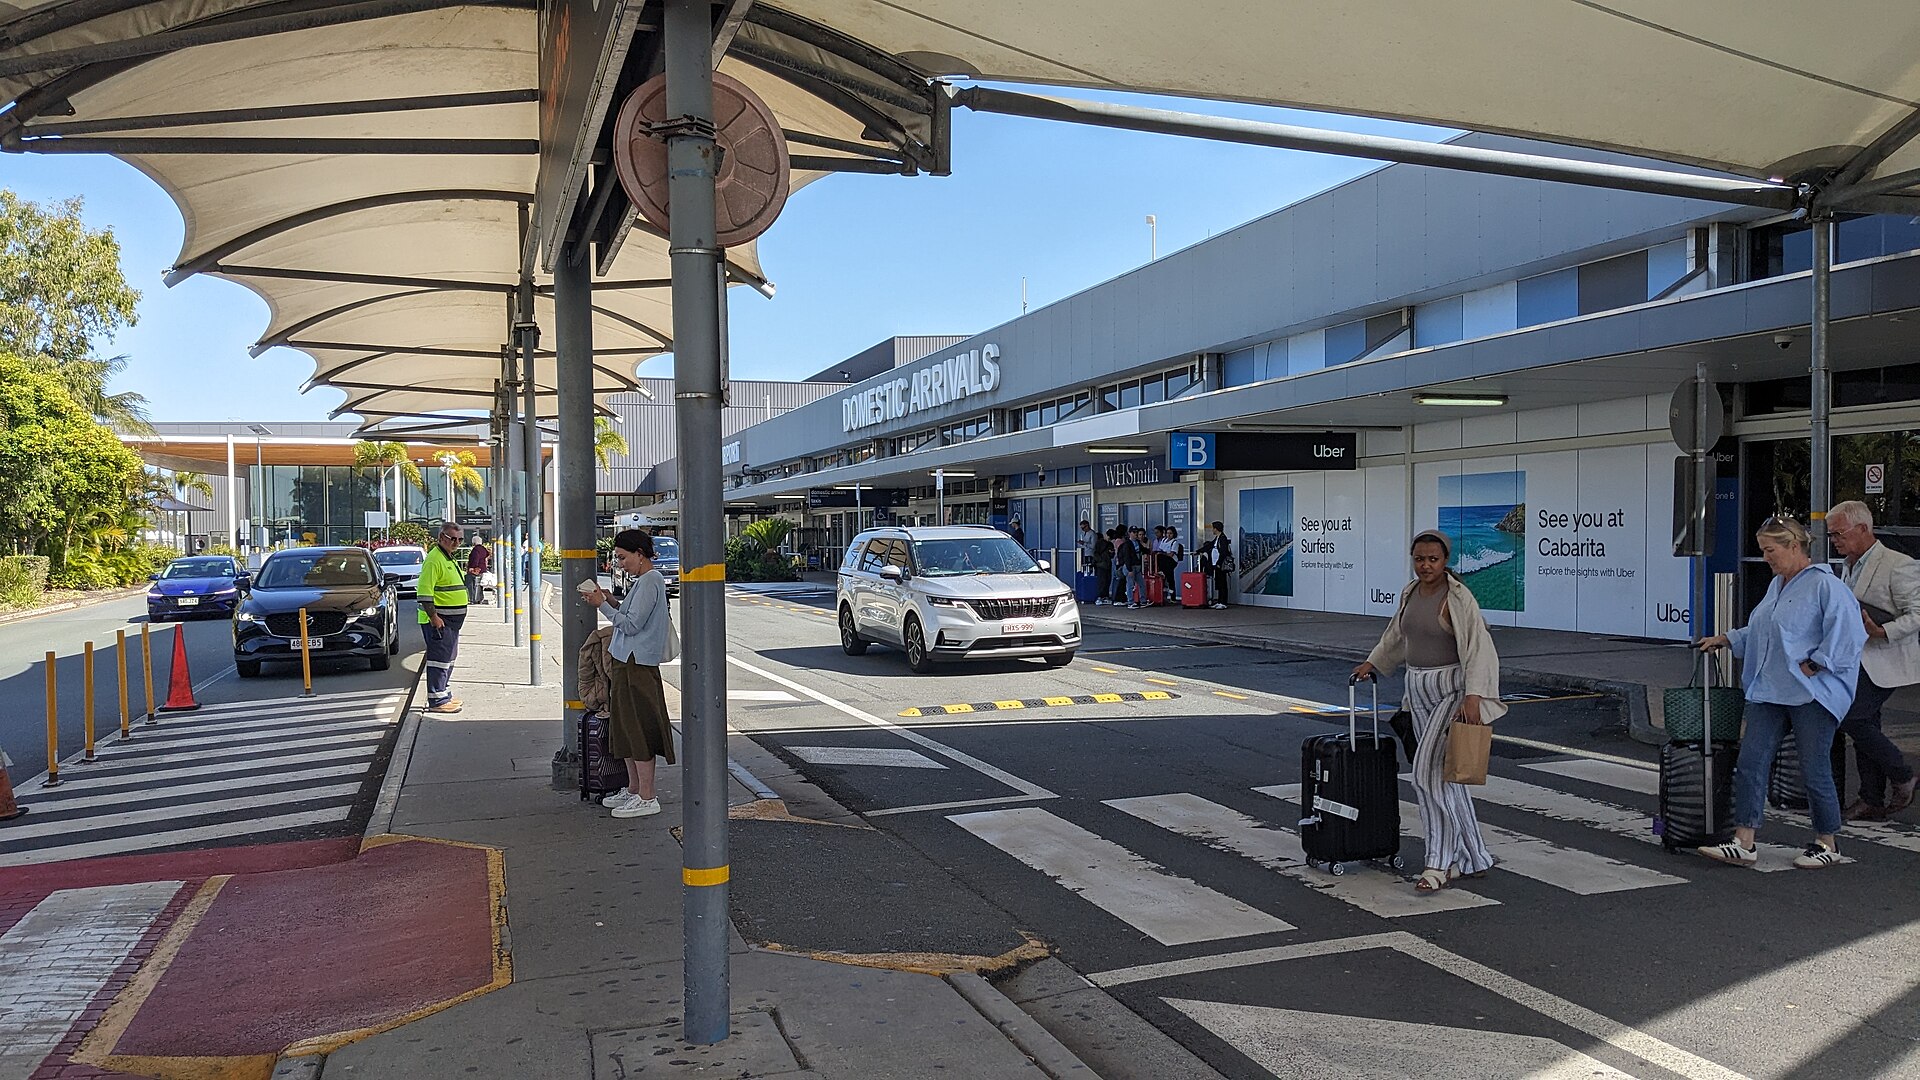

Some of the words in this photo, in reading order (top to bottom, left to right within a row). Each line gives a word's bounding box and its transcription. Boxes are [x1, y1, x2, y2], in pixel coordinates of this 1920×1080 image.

[842, 377, 909, 432] DOMESTIC
[909, 343, 1001, 412] ARRIVALS
[1187, 436, 1208, 466] B
[1313, 444, 1345, 458] Uber
[1104, 459, 1159, 487] WHSmith
[1301, 517, 1320, 532] See
[1321, 519, 1339, 534] you
[1341, 516, 1352, 531] at
[1538, 509, 1569, 529] See
[1573, 513, 1603, 532] you
[1607, 508, 1624, 528] at
[1301, 538, 1335, 554] Surfers
[1538, 537, 1606, 558] Cabarita
[1301, 560, 1316, 569] Explore
[1333, 561, 1342, 569] with
[1342, 561, 1353, 570] Uber
[1538, 565, 1563, 576] Explore
[1564, 566, 1576, 575] the
[1577, 566, 1598, 578] sights
[1600, 567, 1615, 577] with
[1616, 568, 1635, 578] Uber
[1370, 588, 1396, 605] Uber
[1656, 602, 1690, 624] Ube
